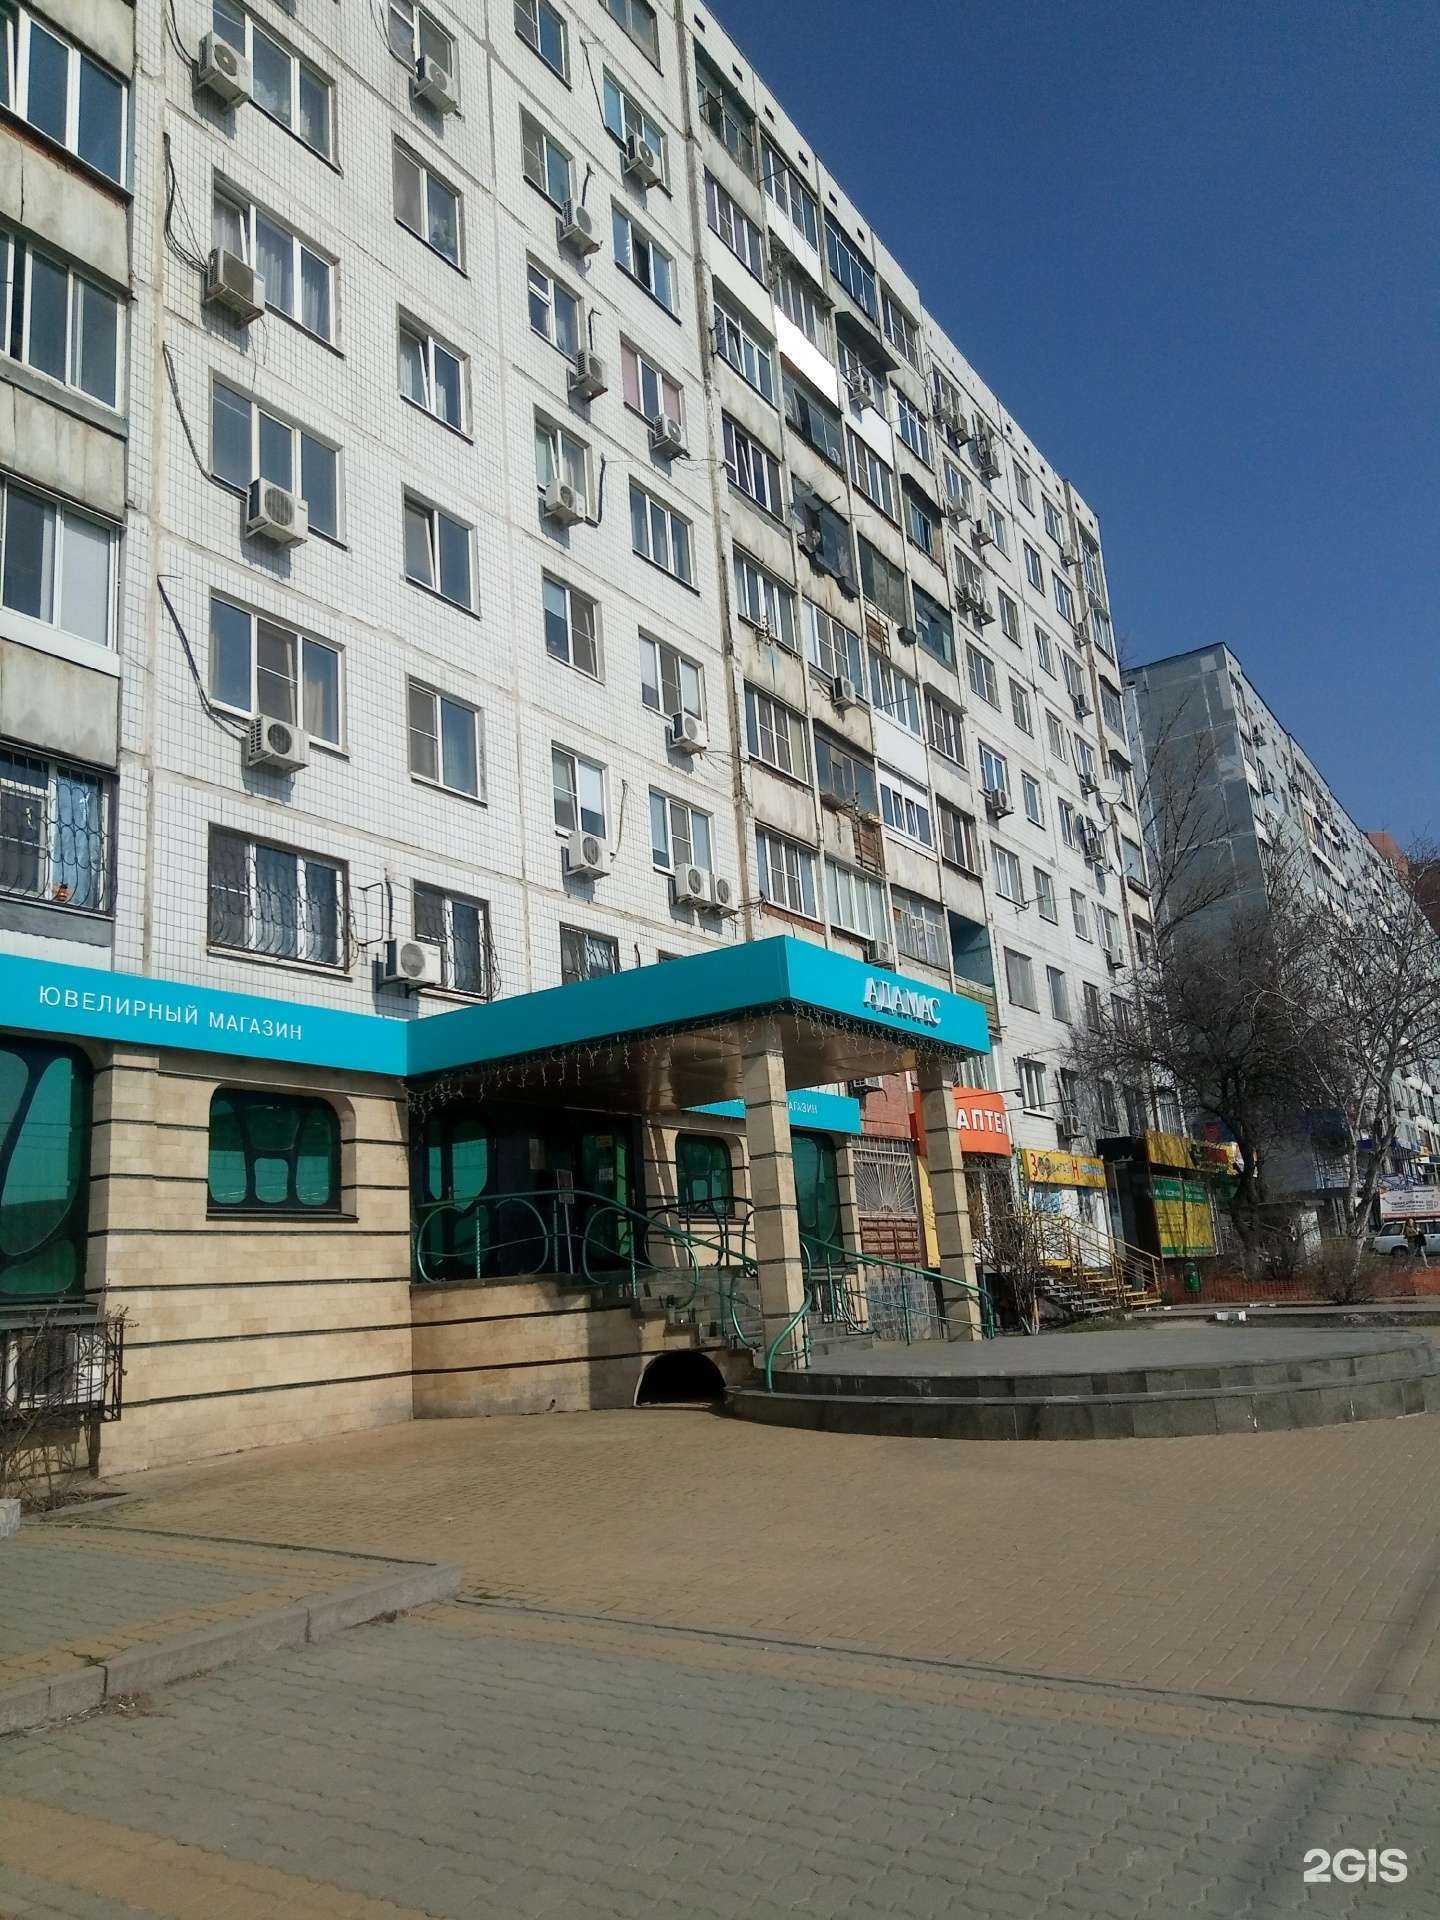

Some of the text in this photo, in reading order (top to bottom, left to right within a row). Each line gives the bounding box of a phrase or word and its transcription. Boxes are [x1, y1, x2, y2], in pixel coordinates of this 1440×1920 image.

[39, 985, 302, 1040] ЮВЕЛИРНЫЙ МАГАЗИН
[863, 977, 942, 1024] АДАМАС
